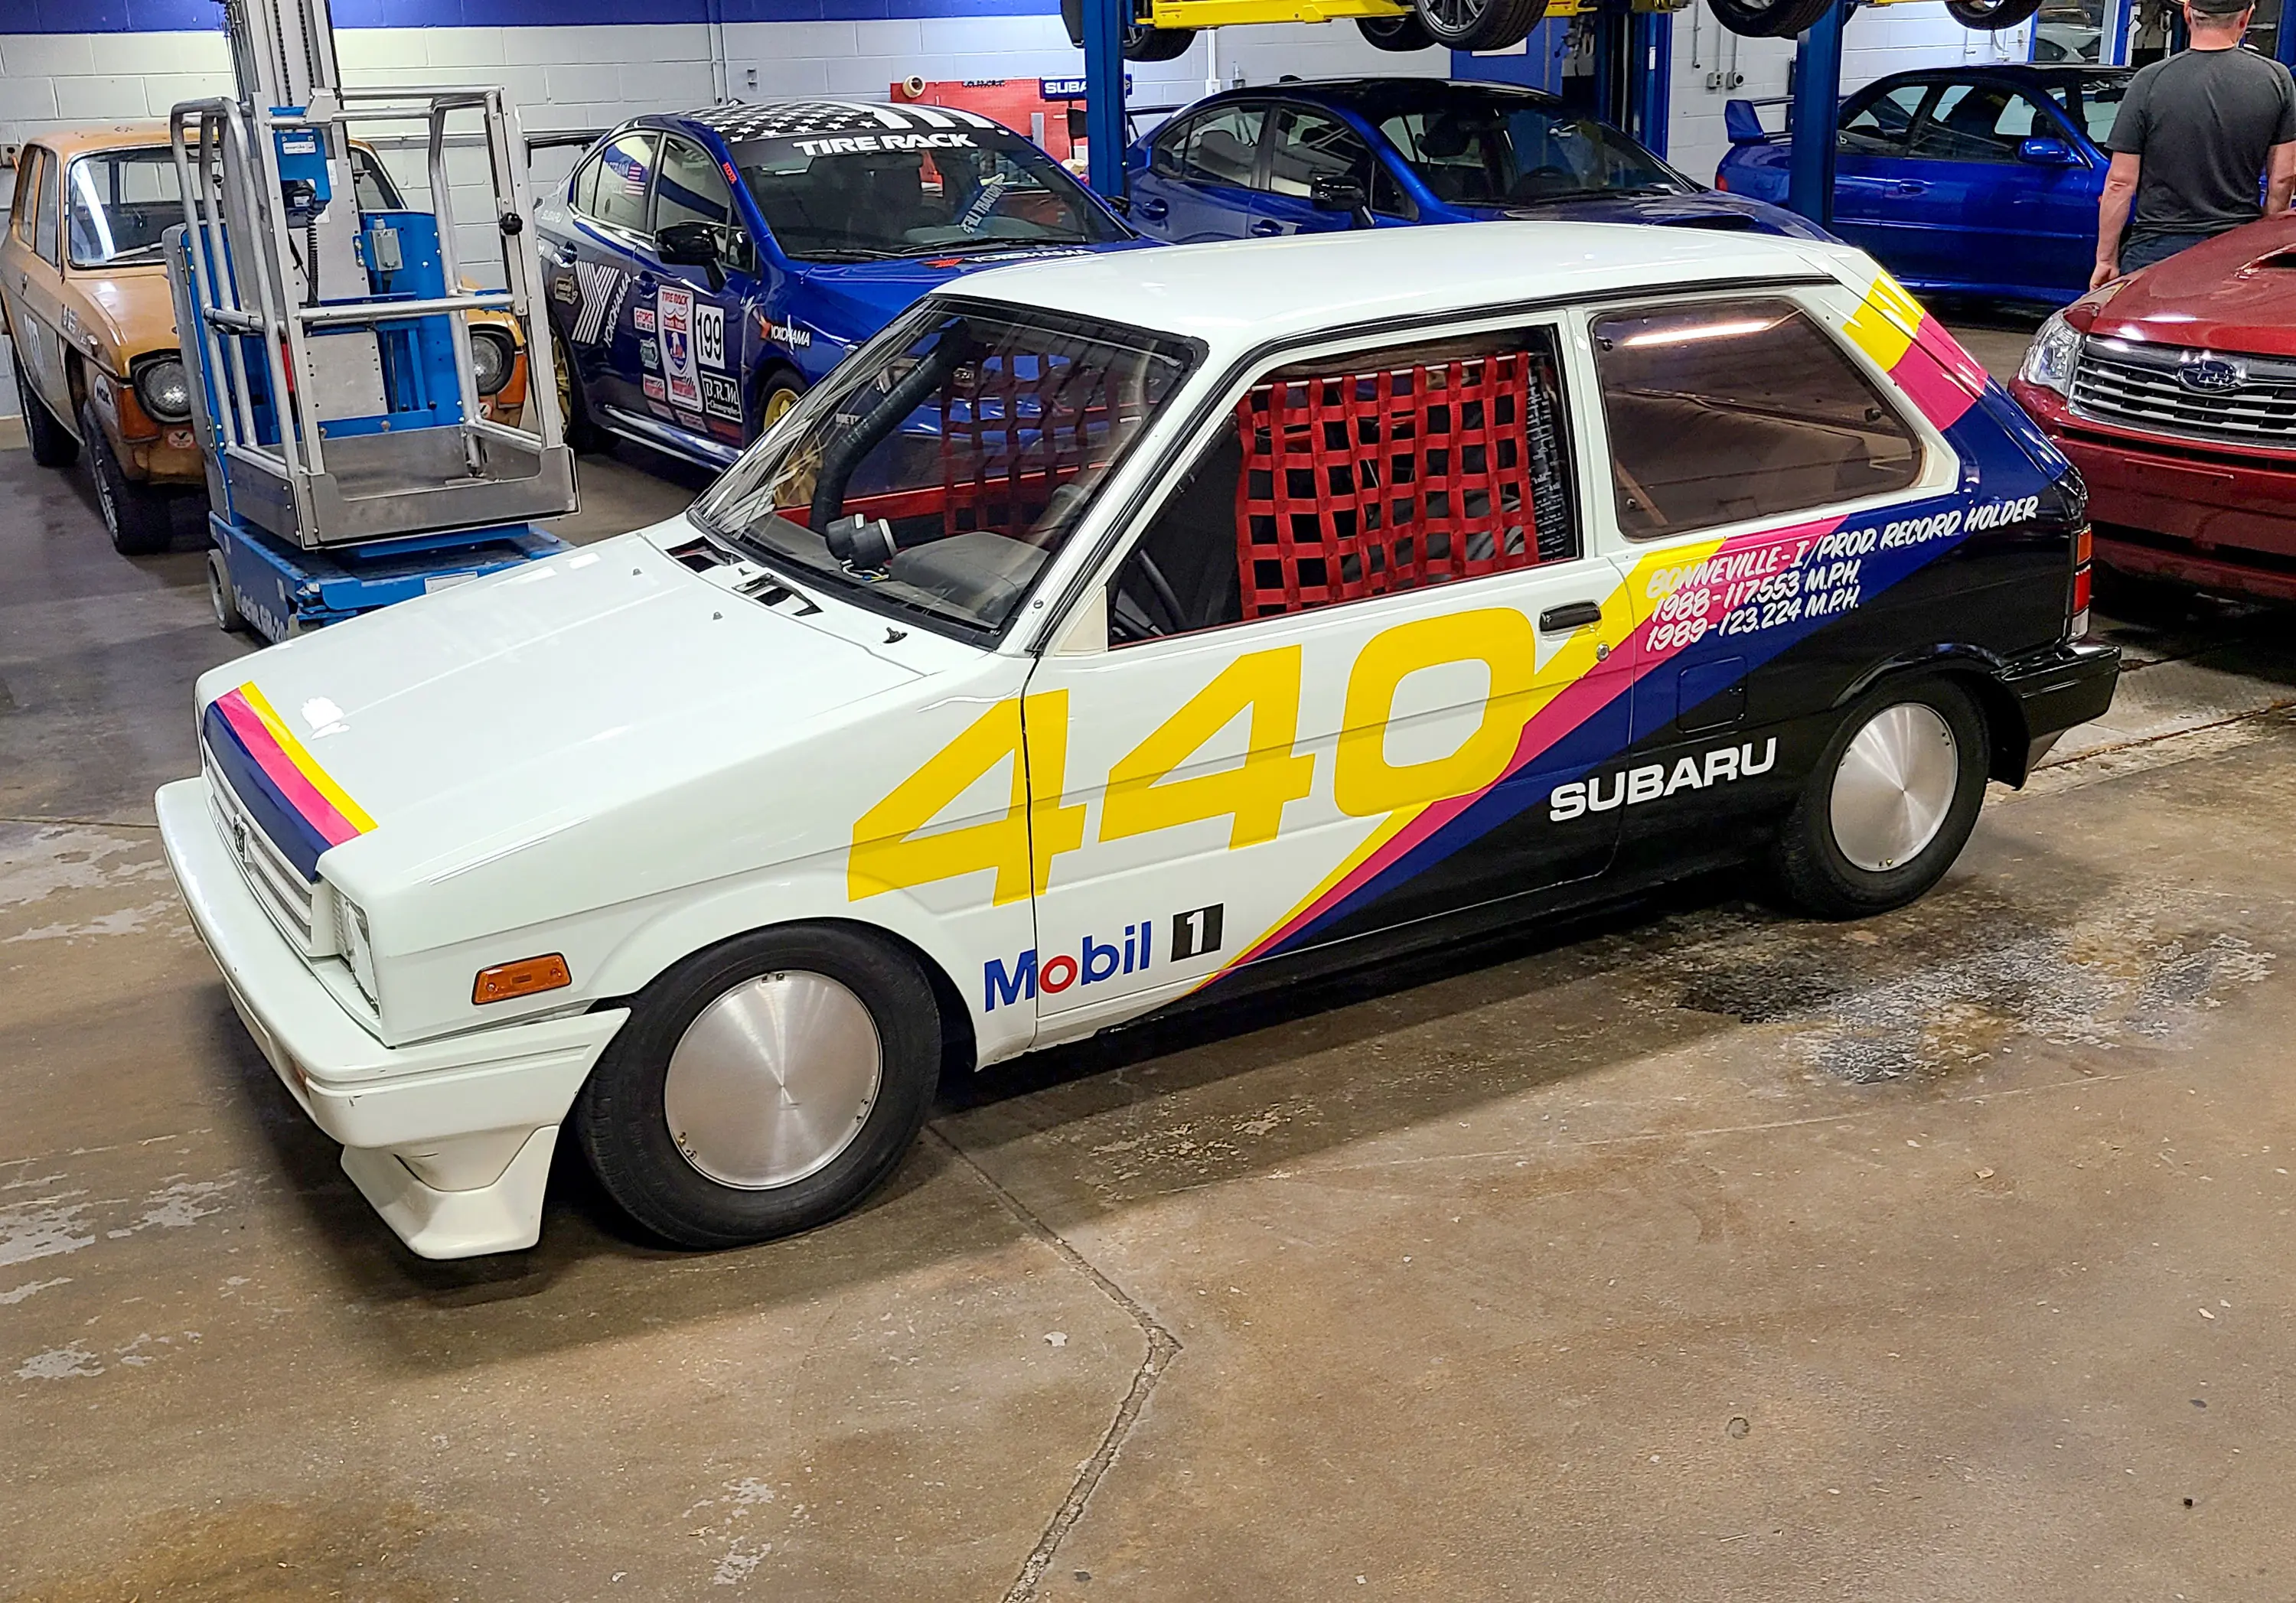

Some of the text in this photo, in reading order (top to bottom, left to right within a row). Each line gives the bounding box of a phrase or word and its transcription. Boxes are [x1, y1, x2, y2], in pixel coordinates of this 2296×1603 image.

[792, 133, 978, 156] TIRE RACK
[603, 271, 632, 349] YOKOHAMA
[697, 311, 722, 362] 199
[1880, 510, 1962, 550] RECORD
[1963, 496, 2039, 533] HOLDER
[846, 608, 1535, 907] 440
[1550, 737, 1777, 822] SUBARU
[984, 920, 1152, 1012] Mobil
